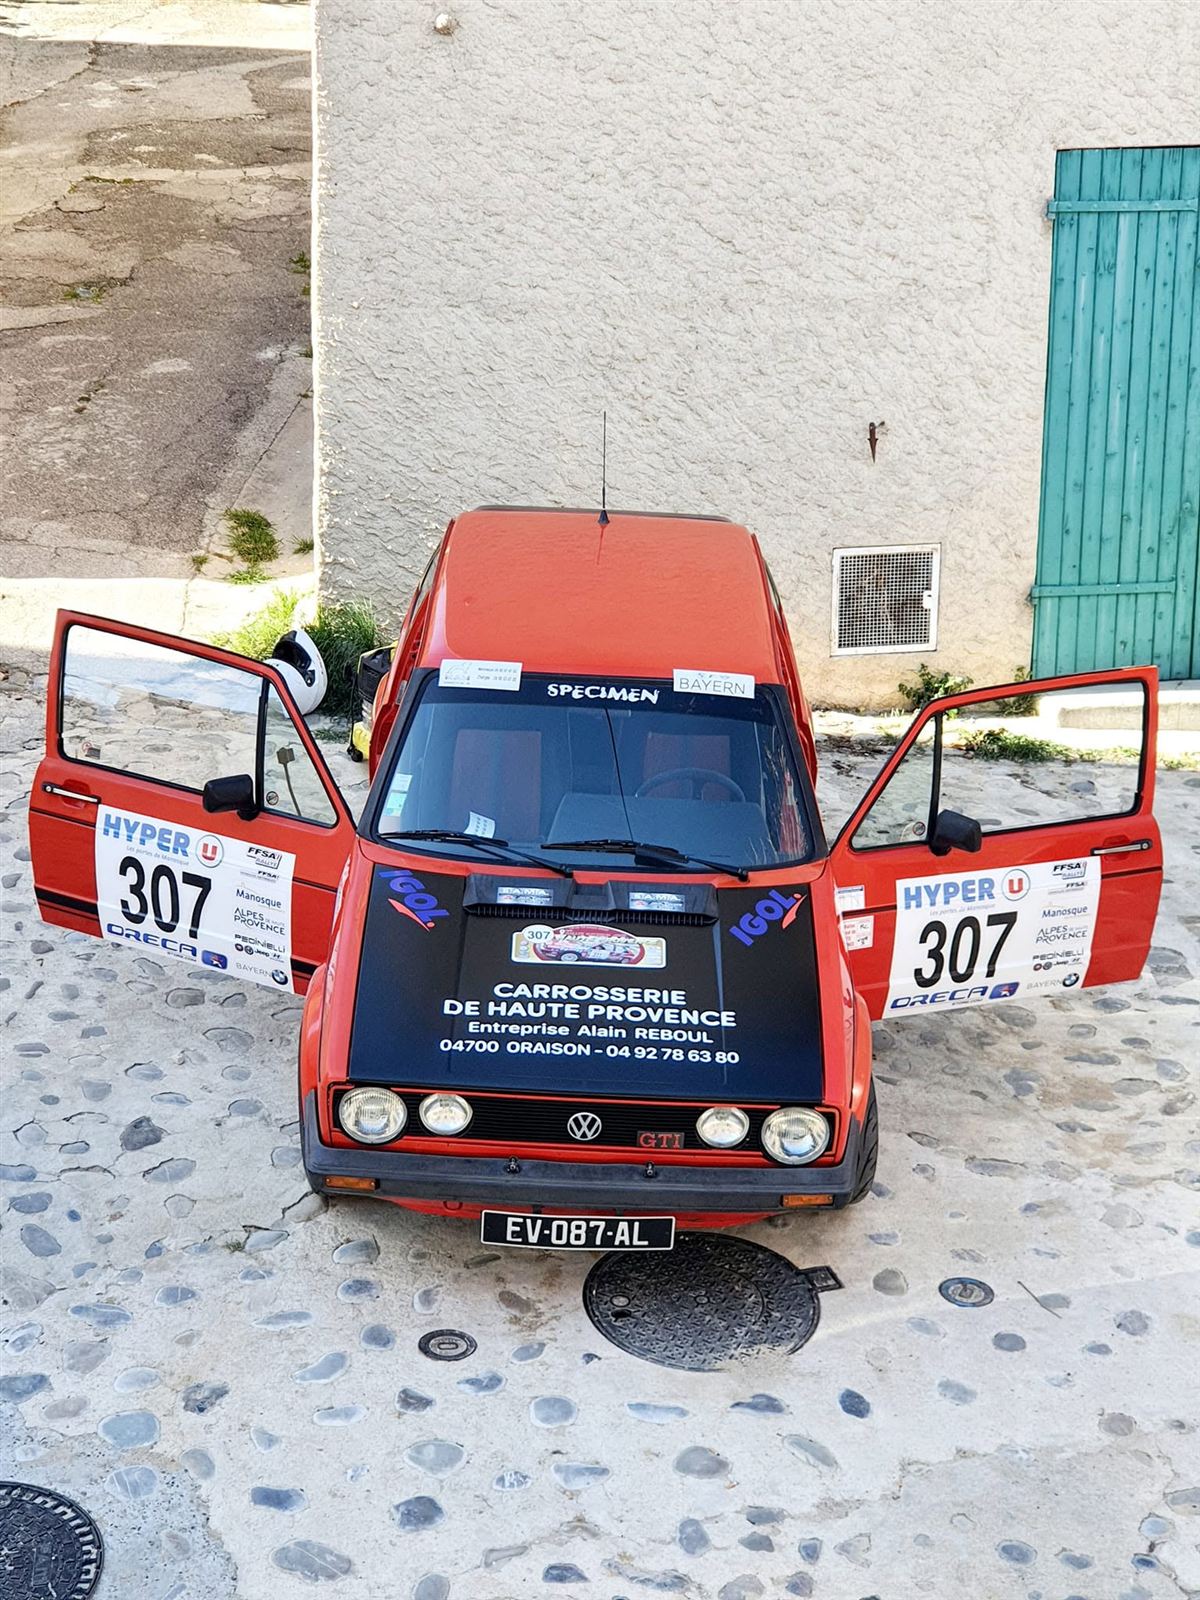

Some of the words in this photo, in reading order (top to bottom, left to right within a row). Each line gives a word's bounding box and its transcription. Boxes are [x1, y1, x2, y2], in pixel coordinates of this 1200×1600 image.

[547, 683, 660, 704] SPECIMEN
[679, 677, 746, 695] BAYERN
[103, 813, 190, 857] HYPER
[201, 842, 218, 861] U
[247, 846, 276, 859] FFSA
[1053, 862, 1081, 872] FFSA
[119, 855, 212, 939] 307
[236, 888, 282, 909] Manosque
[379, 869, 450, 923] IGOL
[904, 877, 995, 910] HYPER
[1008, 878, 1023, 894] U
[234, 907, 264, 921] ALPES
[729, 889, 797, 946] IGOL
[1042, 906, 1088, 918] Manosque
[234, 914, 286, 935] PROVENCE
[527, 930, 551, 940] 307
[1038, 925, 1068, 936] ALPES
[107, 923, 197, 957] ORECA
[1035, 930, 1088, 944] PROVENCE
[914, 911, 1018, 988] 307
[235, 962, 272, 978] BAYERN
[493, 983, 687, 1005] CARROSSERIE
[890, 986, 989, 1009] ORECA
[443, 999, 480, 1016] DE
[488, 1001, 580, 1019] HAUTE
[588, 1004, 737, 1027] PROVENCE
[468, 1021, 570, 1036] Entreprise
[577, 1025, 627, 1038] Alain
[635, 1027, 714, 1043] REBOUL
[440, 1039, 499, 1053] 04700
[506, 1041, 591, 1056] ORAISON
[606, 1045, 631, 1058] 04
[634, 1046, 658, 1059] 92
[661, 1048, 685, 1061] 78
[687, 1049, 712, 1062] 63
[715, 1051, 740, 1064] 80
[639, 1132, 682, 1149] GTI
[506, 1216, 649, 1246] EV-087-AL
